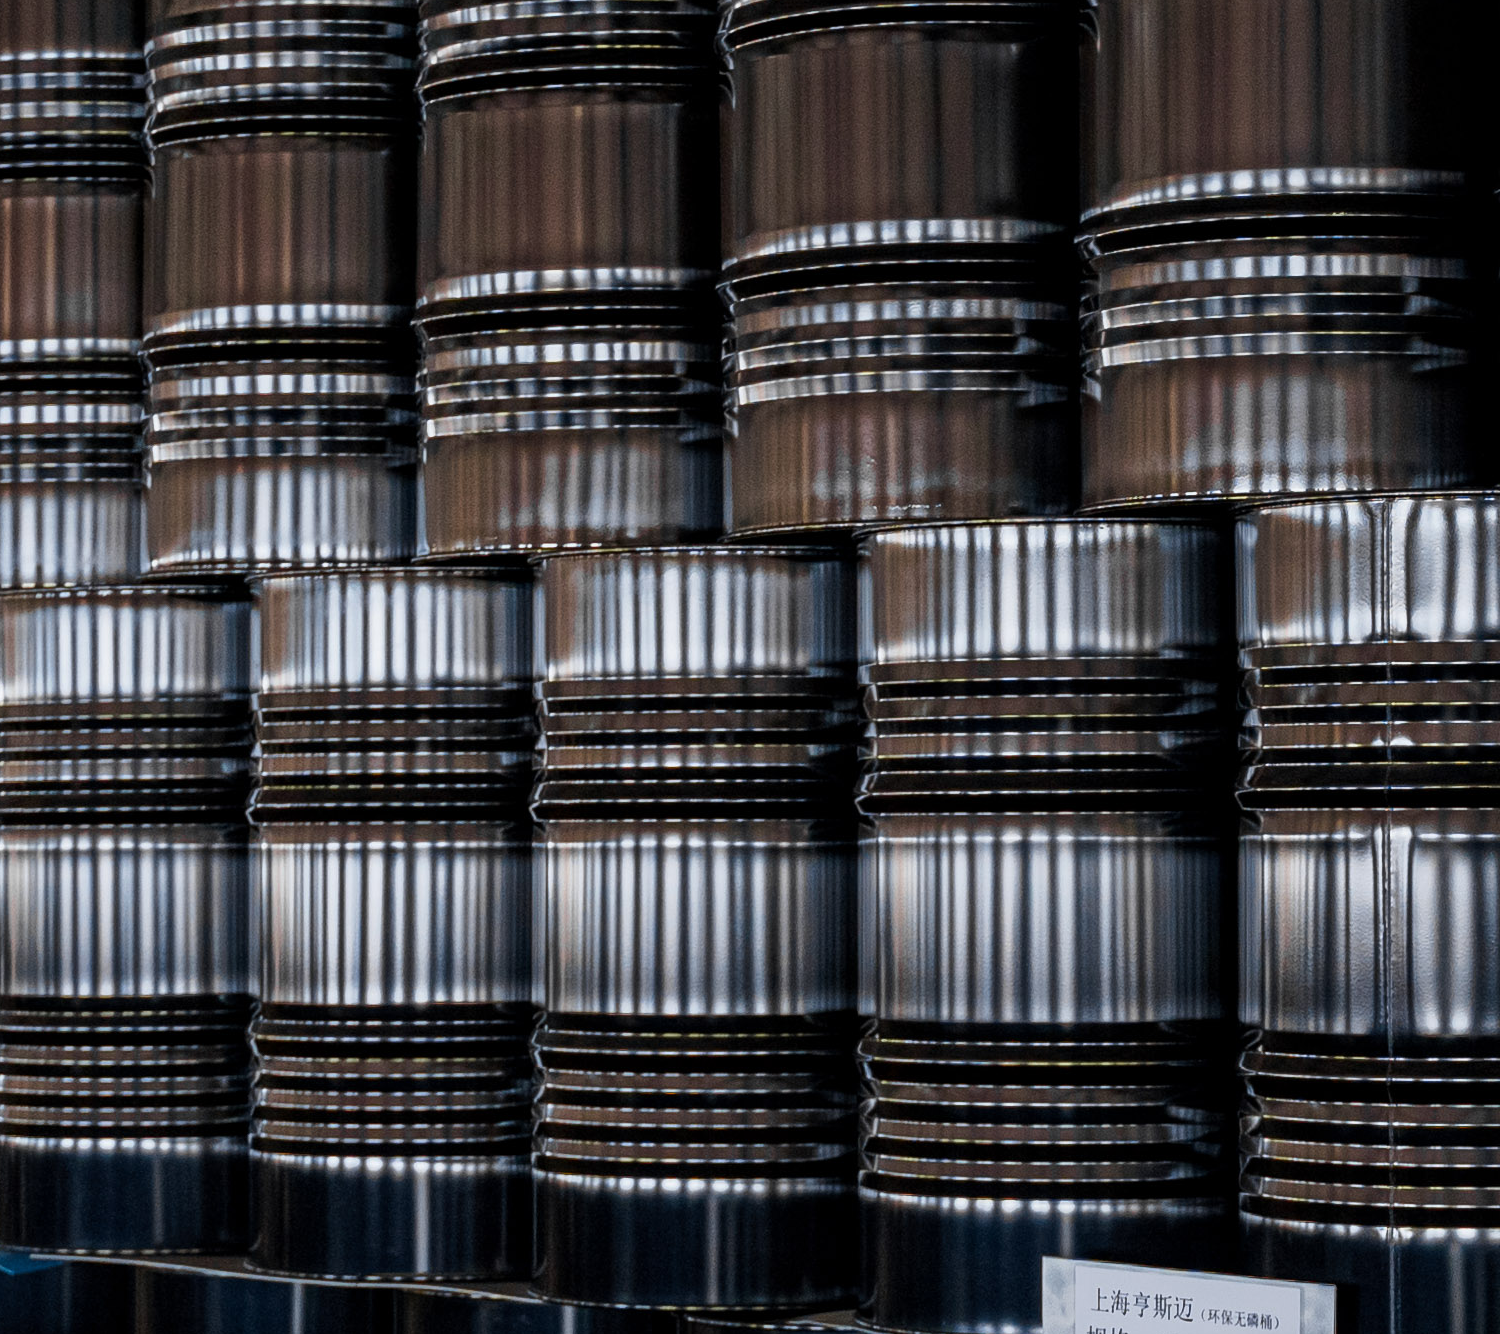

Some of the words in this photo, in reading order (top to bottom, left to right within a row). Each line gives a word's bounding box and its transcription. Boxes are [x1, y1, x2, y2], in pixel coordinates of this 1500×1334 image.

[1091, 1287, 1194, 1323] 上海亨斯迈
